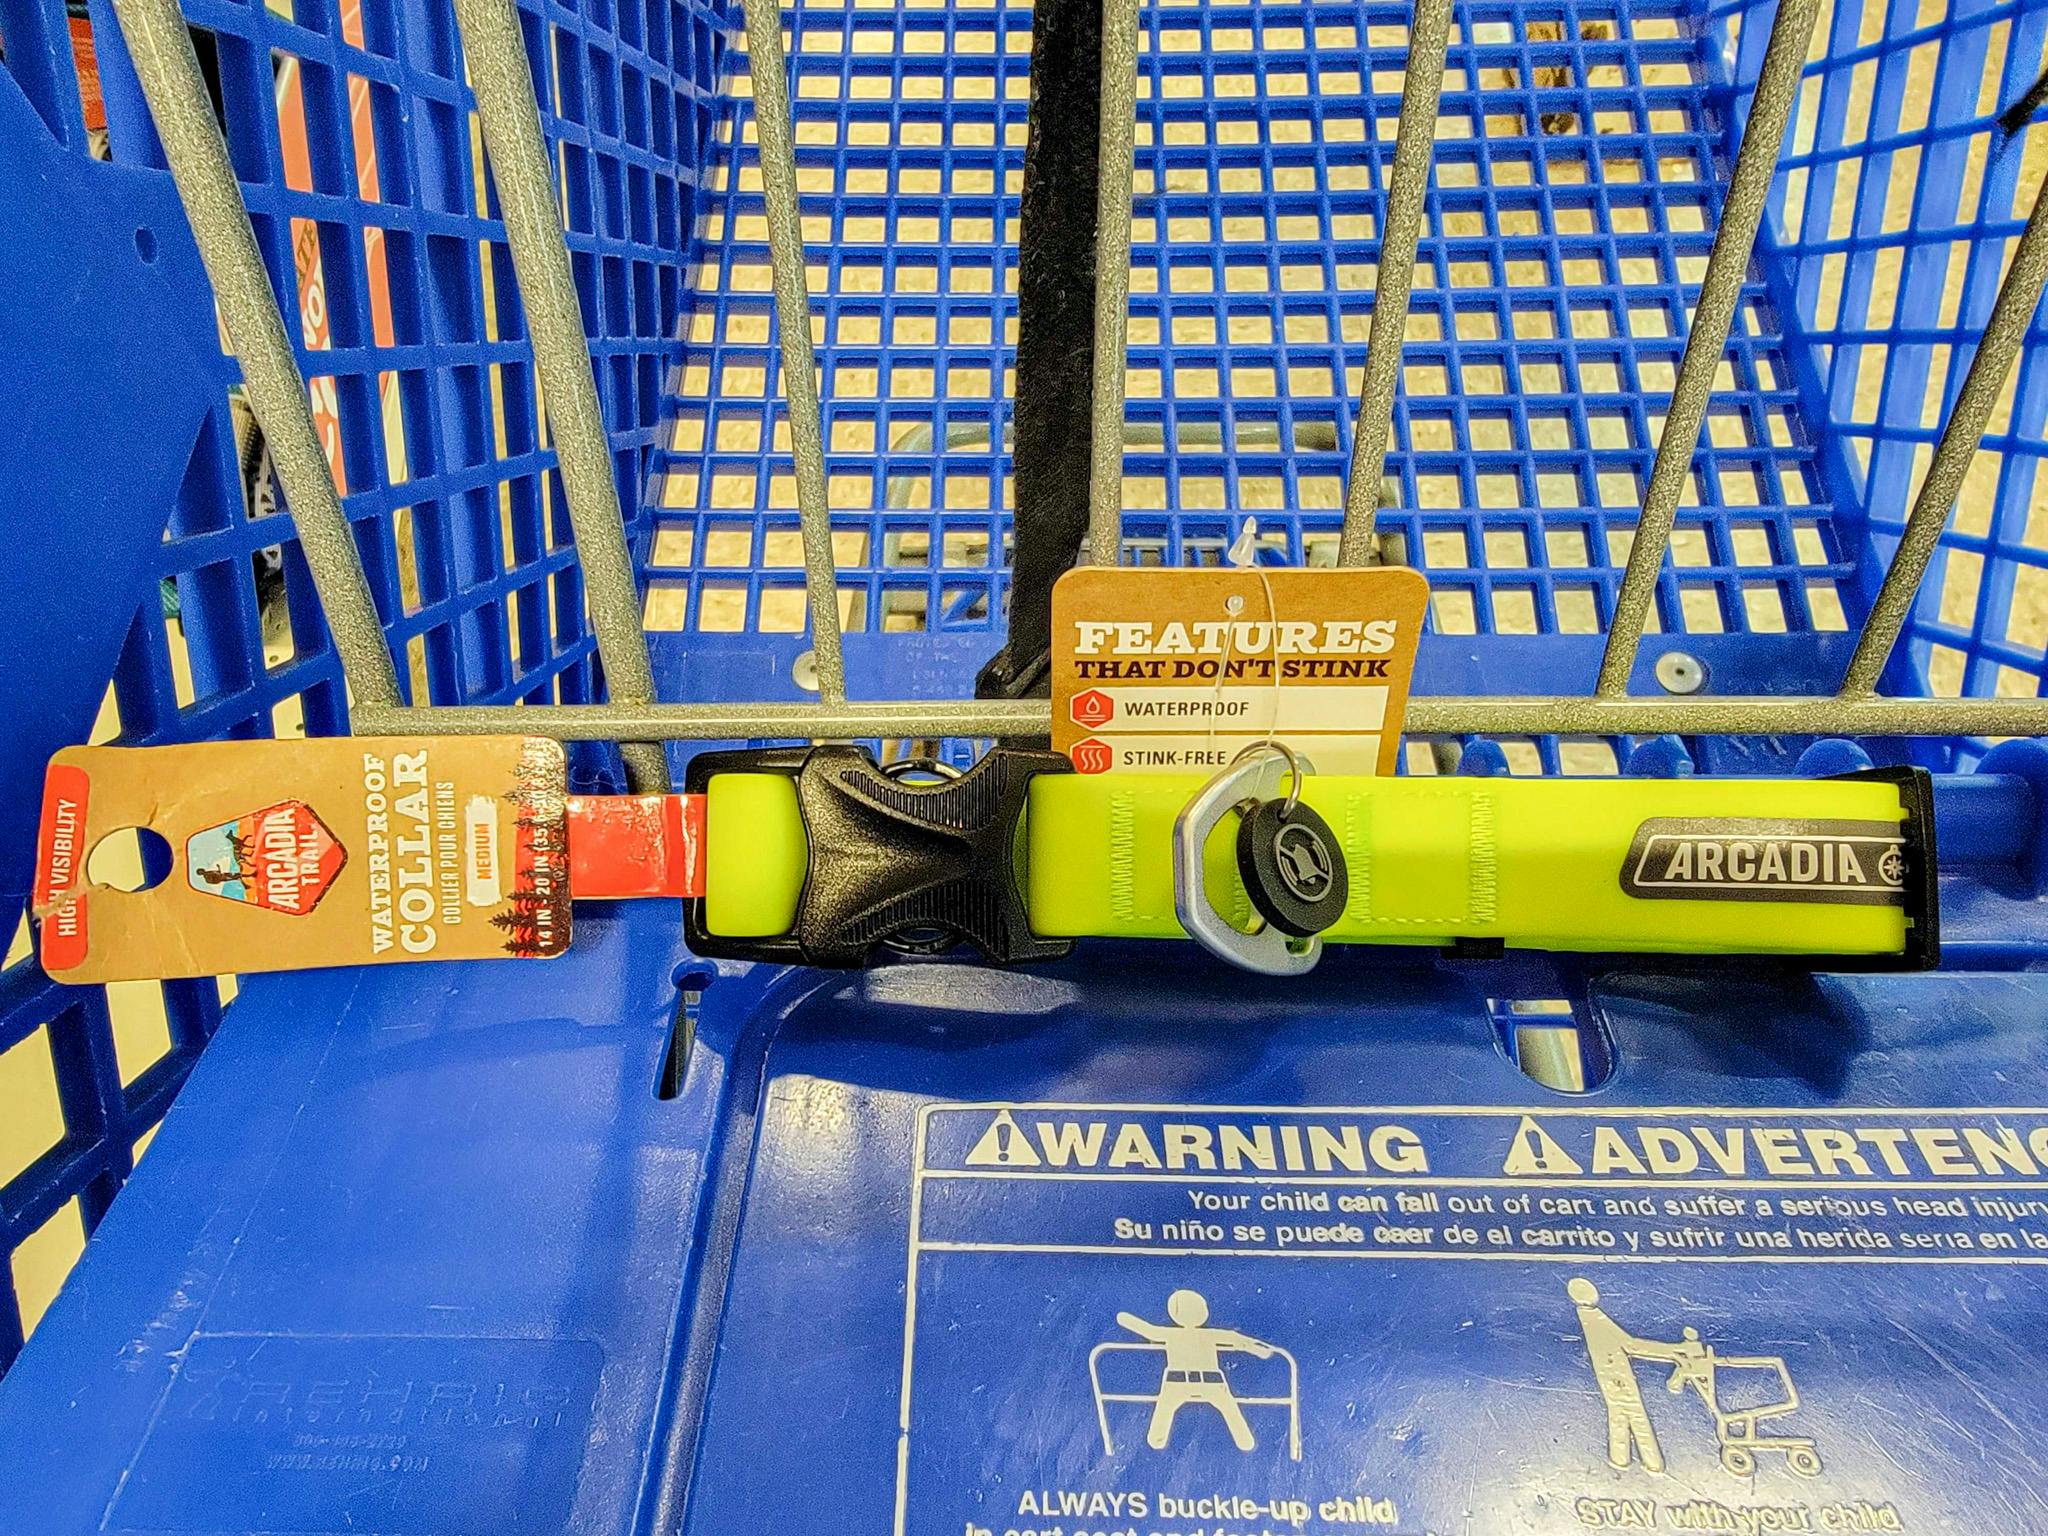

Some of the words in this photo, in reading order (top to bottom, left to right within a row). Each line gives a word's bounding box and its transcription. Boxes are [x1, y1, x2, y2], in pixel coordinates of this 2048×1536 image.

[1074, 619, 1397, 655] FEATURES
[1075, 659, 1170, 679] THAT
[1172, 657, 1277, 679] DON'T
[1281, 658, 1392, 678] STINK
[1124, 701, 1249, 717] WATERPROOF
[1123, 750, 1227, 766] STINK-FREE
[435, 781, 456, 829] CHIENS
[50, 798, 77, 885] VISIBILITY
[263, 807, 300, 910] ARCADIA
[299, 827, 321, 887] TRAIL
[363, 753, 395, 954] WATERPROOF
[393, 750, 436, 954] COLLAR
[439, 834, 458, 868] POUR
[474, 823, 492, 880] MEDIUM
[534, 856, 549, 873] IN
[1663, 841, 1867, 884] ARCADIA
[440, 872, 462, 925] COLLIER
[535, 879, 550, 895] 20
[537, 909, 552, 926] IN
[538, 931, 552, 946] 14
[1036, 1121, 1430, 1174] WARNING
[1187, 1190, 1250, 1210] Your
[1261, 1191, 1331, 1212] child
[1337, 1195, 1389, 1213] can
[1395, 1191, 1440, 1213] fall
[1448, 1194, 1495, 1213] out
[1502, 1193, 1531, 1214] of
[1539, 1196, 1596, 1215] cart
[1605, 1196, 1657, 1216] and
[1664, 1196, 1747, 1216] suffer
[1755, 1199, 1774, 1216] a
[1780, 1196, 1888, 1217] serious
[1892, 1196, 1969, 1217] head
[1113, 1217, 1152, 1240] Su
[1162, 1219, 1225, 1241] niño
[1233, 1225, 1266, 1242] se
[1276, 1222, 1365, 1247] puede
[1373, 1225, 1434, 1244] caer
[1443, 1224, 1480, 1245] de
[1486, 1225, 1513, 1246] el
[1521, 1225, 1616, 1247] carrito
[1622, 1230, 1639, 1252] y
[1650, 1227, 1725, 1248] sufrir
[1734, 1231, 1793, 1248] una
[1796, 1227, 1893, 1248] herida
[1978, 1231, 2018, 1249] en
[1018, 1490, 1148, 1518] ALWAYS
[1158, 1493, 1311, 1530] buckle-up
[1318, 1496, 1398, 1526] child
[1576, 1497, 1657, 1529] STAY
[1664, 1500, 1738, 1530] with
[1739, 1504, 1811, 1536] your
[1819, 1500, 1904, 1532] child
